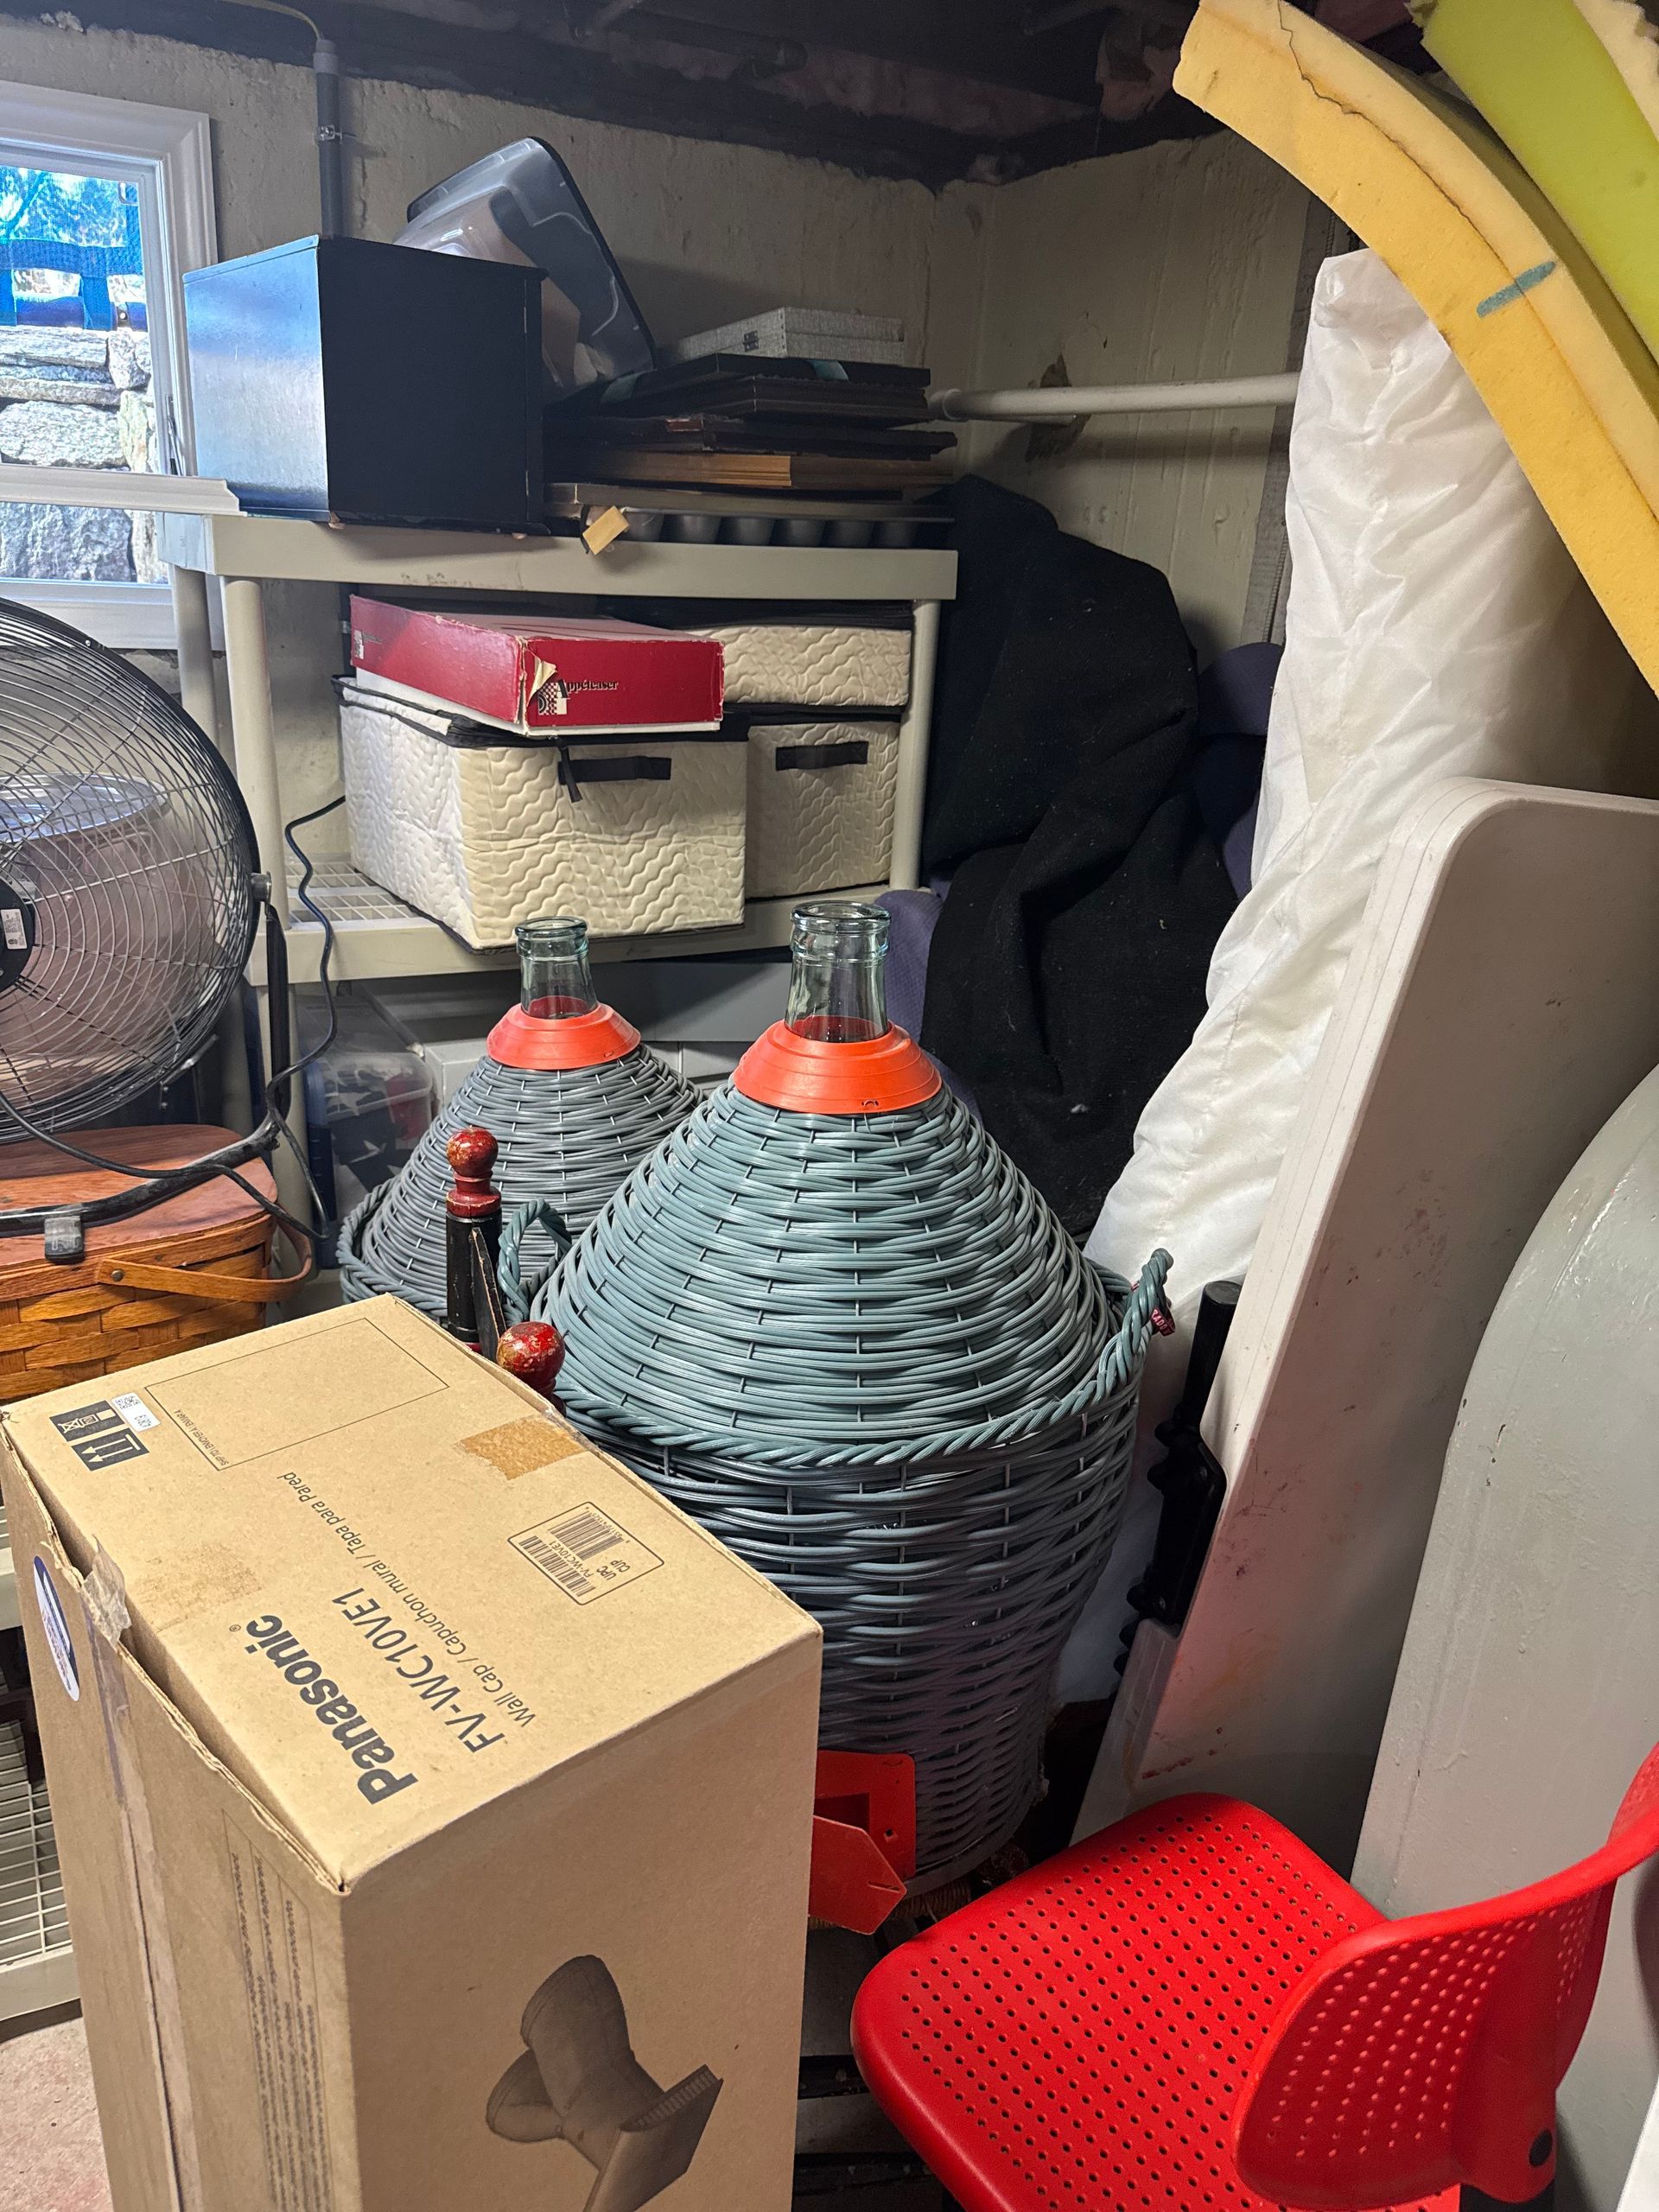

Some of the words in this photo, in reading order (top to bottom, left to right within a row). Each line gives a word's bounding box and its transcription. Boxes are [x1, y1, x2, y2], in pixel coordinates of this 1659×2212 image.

[191, 1429, 214, 1449] ENVOYER
[209, 1449, 221, 1458] TO
[214, 1454, 230, 1466] SHIP
[276, 1471, 317, 1503] Pared
[311, 1501, 346, 1525] para
[335, 1525, 365, 1554] Tapa
[548, 1541, 594, 1578] FV-WC10VE1
[596, 1566, 617, 1581] UPC
[611, 1560, 631, 1573] CUP
[363, 1560, 408, 1594] mural
[403, 1592, 467, 1656] Capuchon
[331, 1587, 505, 1753] FV-WC10VE1
[473, 1663, 504, 1693] Cap
[244, 1614, 419, 1805] Panasonic
[493, 1691, 536, 1727] Wall
